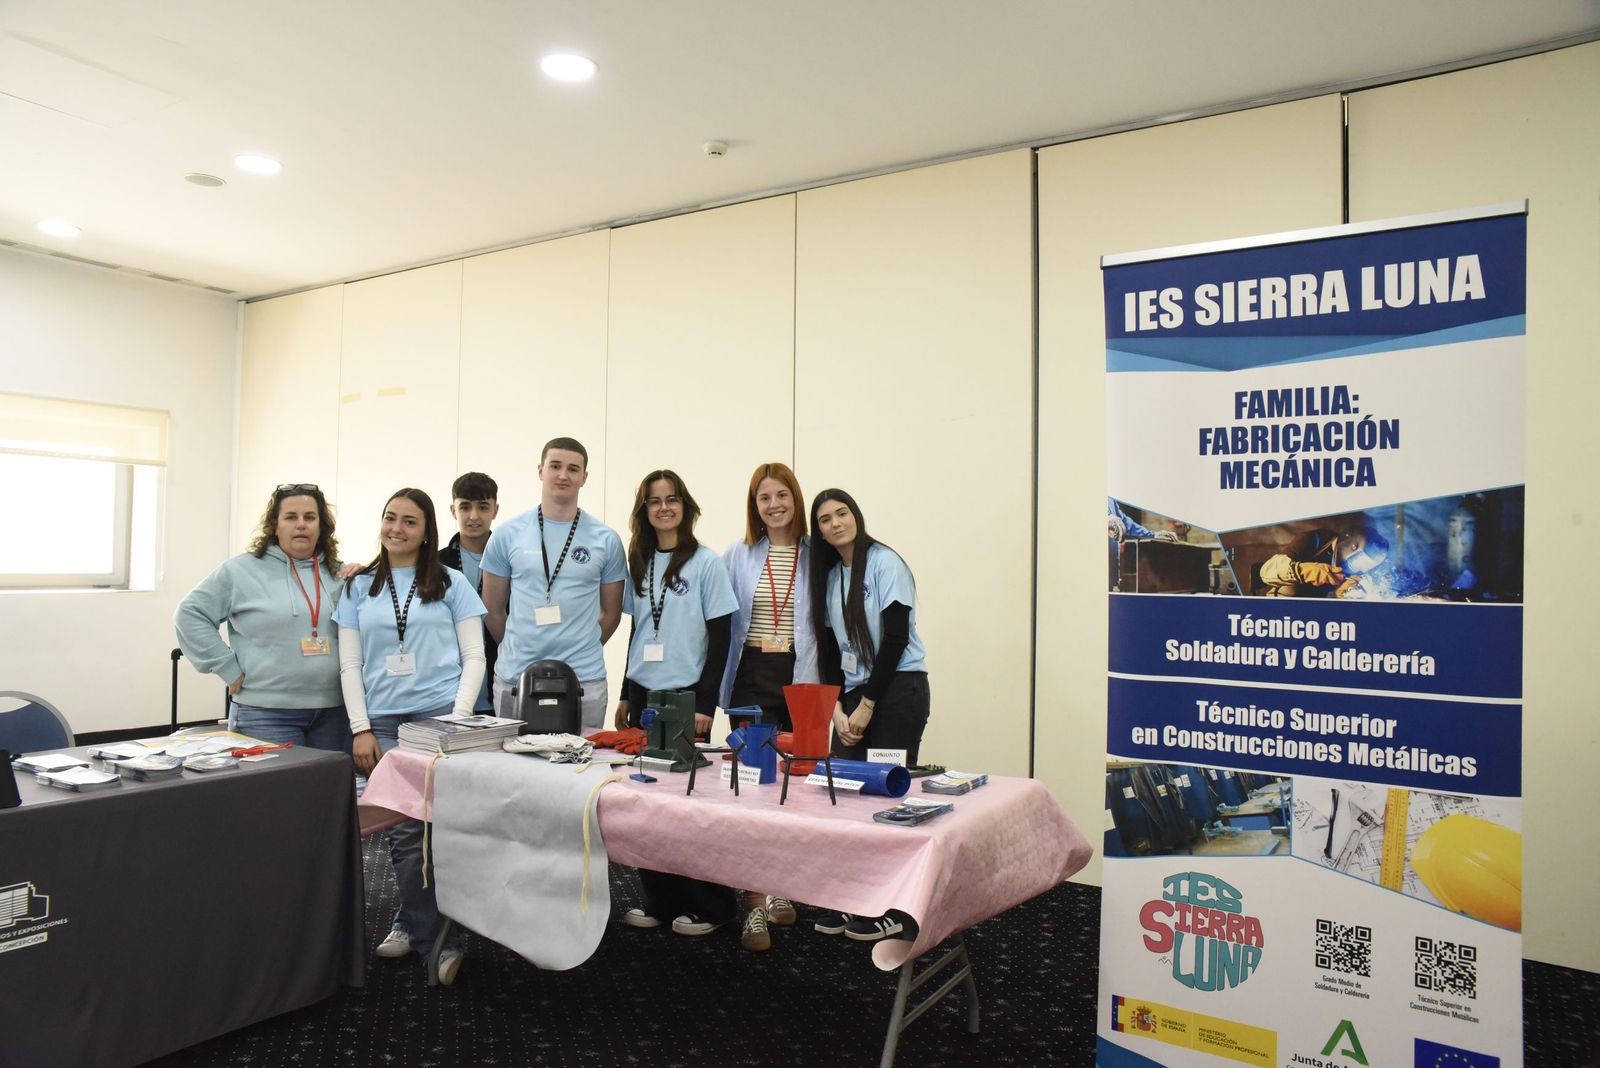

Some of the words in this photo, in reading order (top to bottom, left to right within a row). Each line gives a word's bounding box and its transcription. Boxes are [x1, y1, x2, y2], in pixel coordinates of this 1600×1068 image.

[1124, 287, 1184, 333] IES
[1194, 269, 1350, 327] SIERRA
[1361, 254, 1486, 311] LUNA
[1234, 385, 1360, 420] FAMILIA:
[1199, 414, 1400, 456] FABRICACIÓN
[1219, 454, 1377, 490] MECÁNICA
[1228, 613, 1320, 640] Técnico
[1325, 621, 1356, 641] en
[1165, 639, 1279, 667] Soldadura
[1284, 651, 1298, 671] y
[1302, 646, 1436, 676] Calderería
[1196, 700, 1285, 729] Técnico
[1289, 708, 1398, 739] Superior
[872, 751, 901, 759] CONJUNTO
[1131, 725, 1158, 746] en
[1162, 725, 1342, 764] Construcciones
[1348, 742, 1477, 778] Metálicas
[1162, 871, 1243, 914] IES
[18, 918, 68, 935] EXPOSICIONES
[1139, 900, 1264, 954] SIERRA
[1172, 931, 1263, 992] LUNA
[1314, 982, 1339, 993] Soldadura
[1322, 975, 1337, 984] Grado
[1338, 978, 1354, 987] Medio
[1355, 981, 1361, 989] de
[1409, 1001, 1450, 1017] Construcciones
[1451, 1010, 1480, 1024] Metálicas
[1418, 994, 1438, 1005] Técnico
[1440, 999, 1463, 1010] Superior
[1161, 1018, 1187, 1029] GOBIERNO
[1198, 1027, 1227, 1038] MINISTERIO
[1234, 1045, 1270, 1059] PROFESIONAL
[1291, 1053, 1323, 1068] Junta
